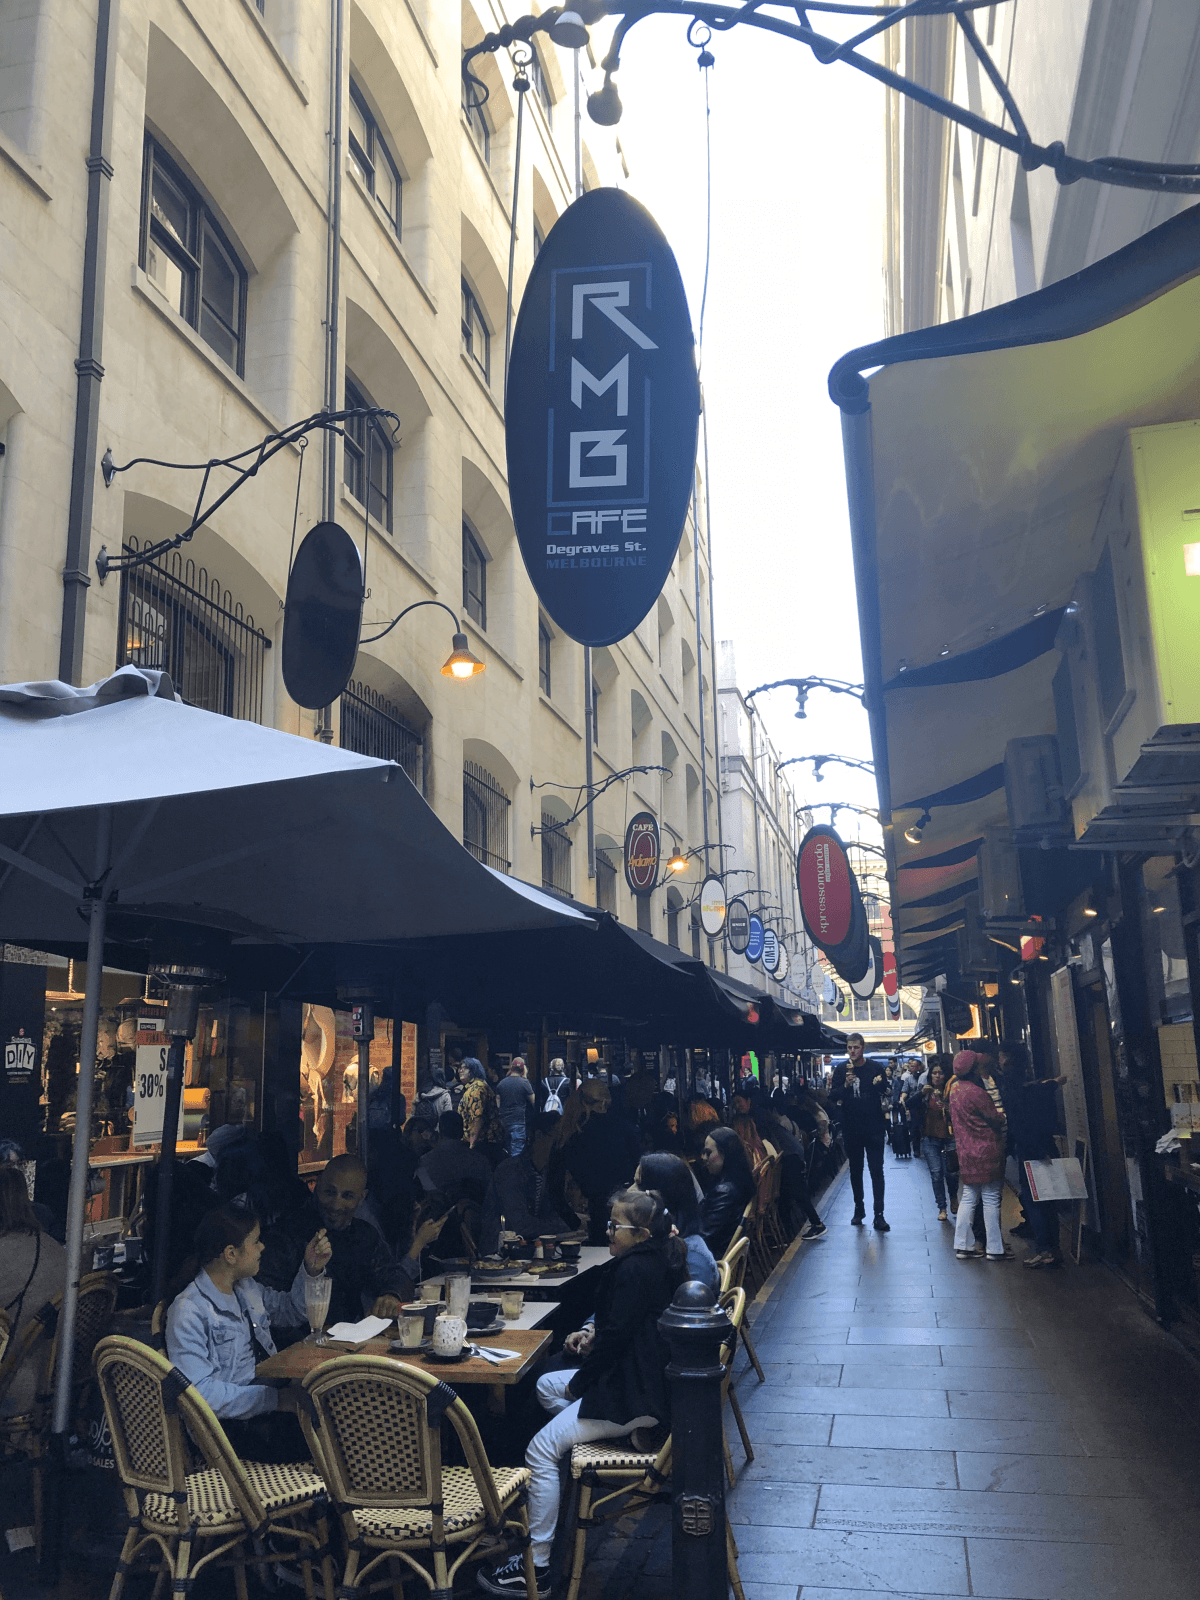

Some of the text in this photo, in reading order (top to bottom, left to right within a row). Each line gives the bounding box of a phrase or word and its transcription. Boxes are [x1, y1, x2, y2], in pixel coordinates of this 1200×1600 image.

[547, 508, 647, 535] CAFE
[546, 541, 647, 556] Degraves St.
[546, 556, 647, 569] MELBOURNE
[7, 1049, 34, 1065] DIY
[140, 1073, 164, 1098] 30%
